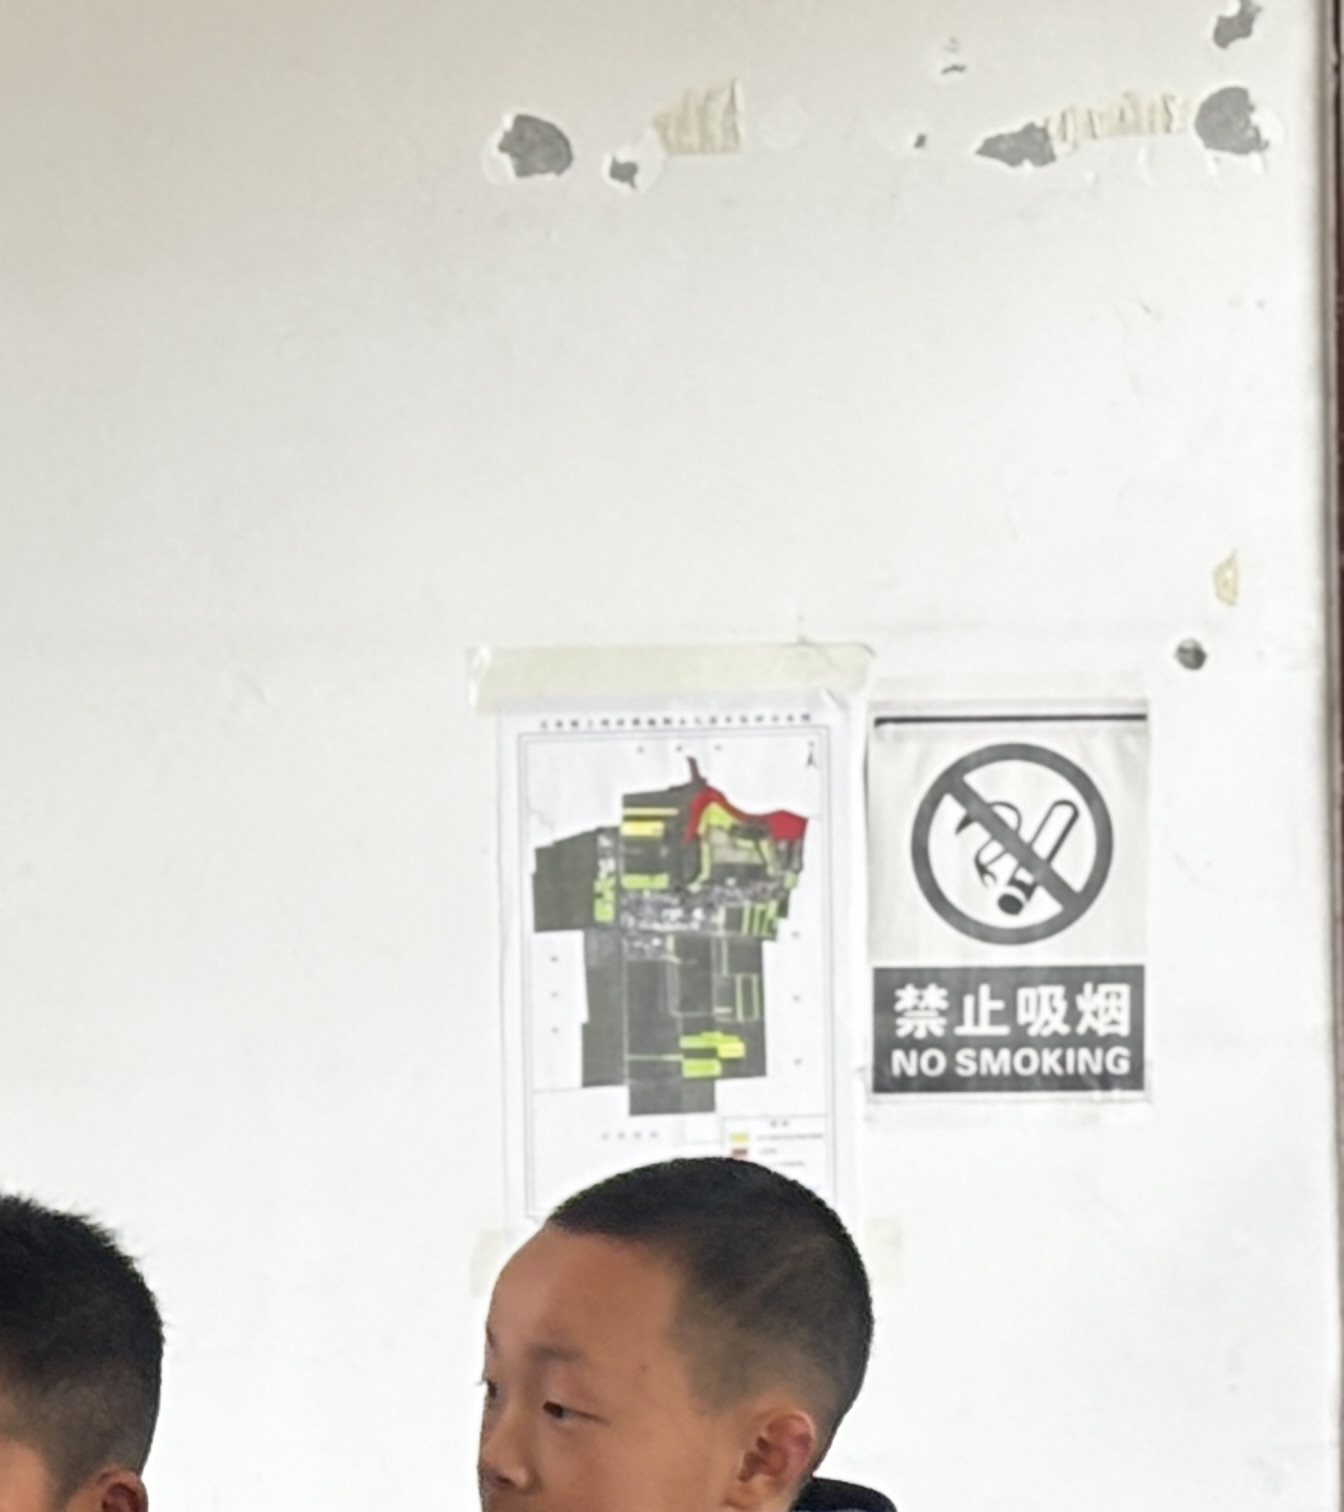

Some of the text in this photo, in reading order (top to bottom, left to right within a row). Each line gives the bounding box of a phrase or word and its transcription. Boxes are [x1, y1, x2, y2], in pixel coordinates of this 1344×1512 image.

[894, 982, 1131, 1040] 禁止吸烟
[891, 1045, 1131, 1078] NO SMOKING
